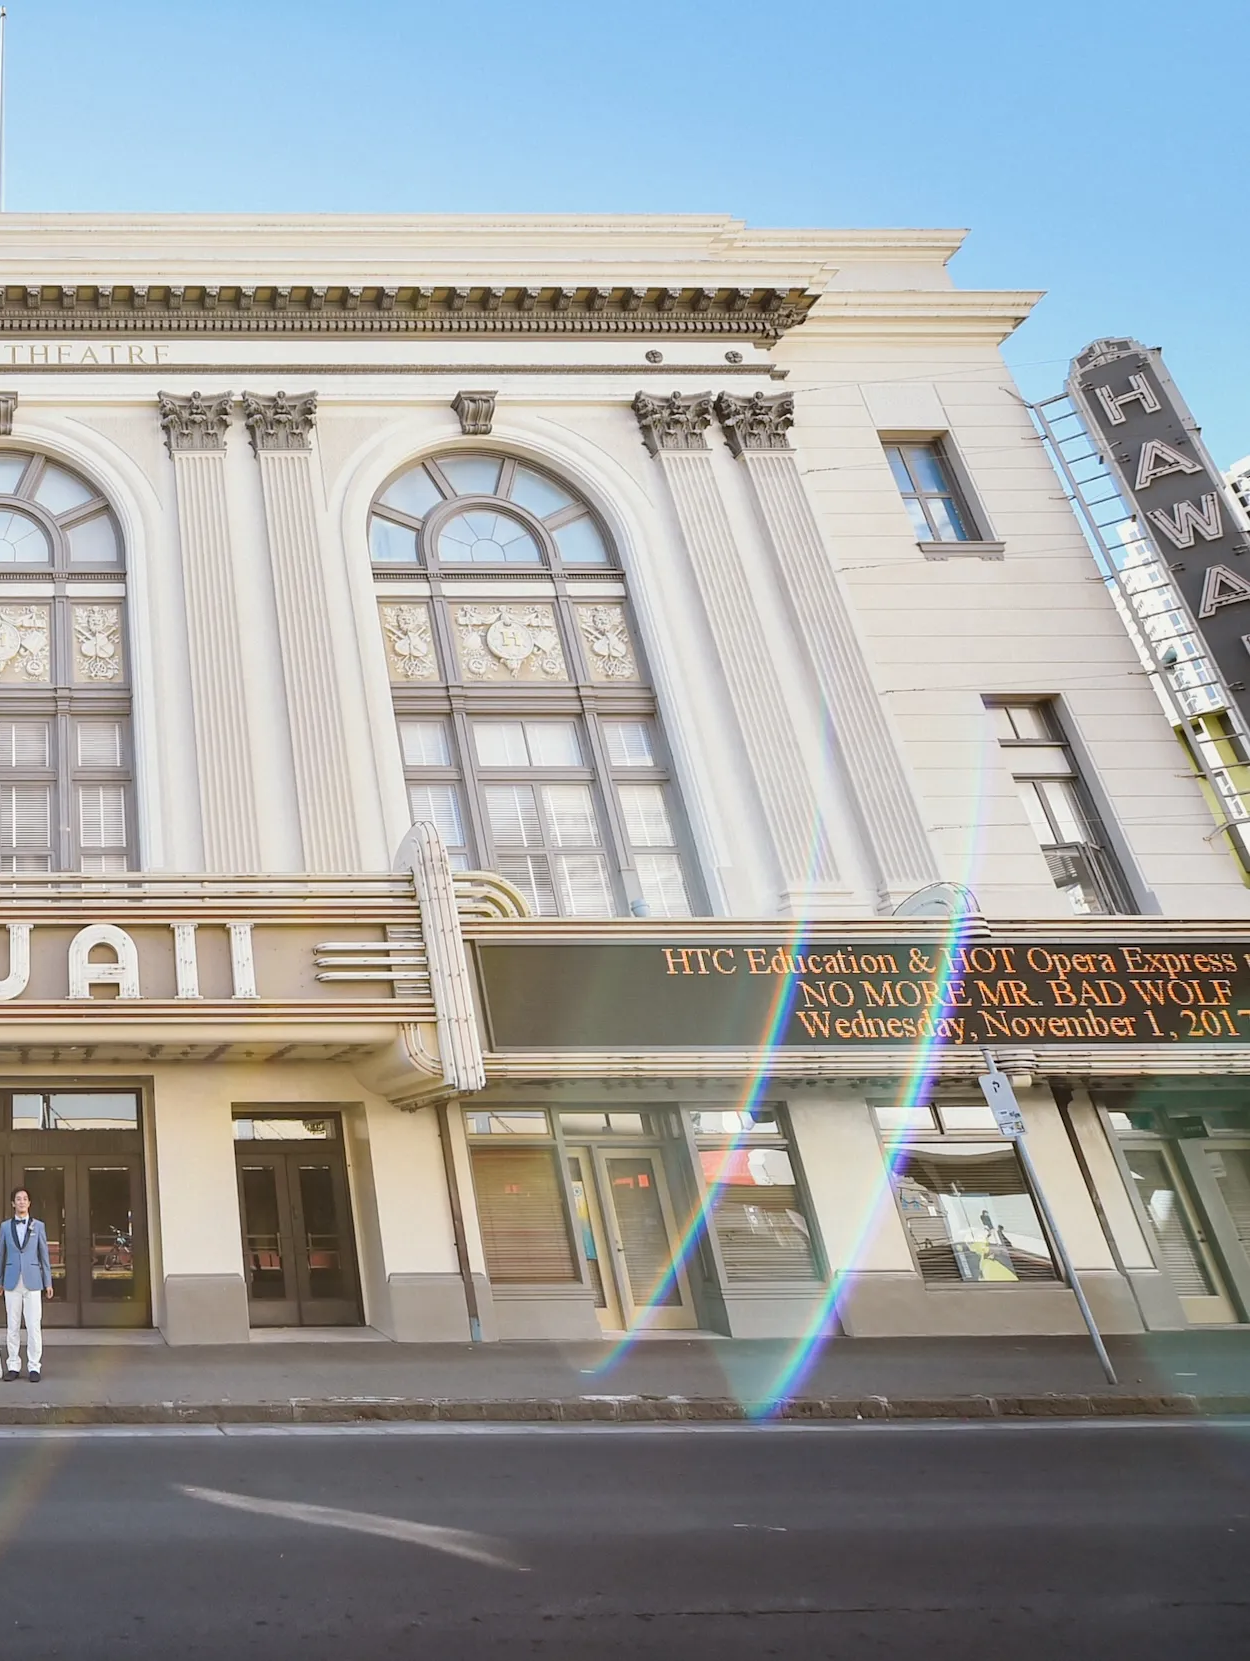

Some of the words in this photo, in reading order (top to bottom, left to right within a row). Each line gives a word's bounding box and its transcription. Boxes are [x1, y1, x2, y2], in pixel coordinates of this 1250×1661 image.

[4, 344, 170, 364] THEATRE
[500, 630, 523, 647] H
[661, 948, 737, 975] HTC
[743, 946, 900, 975] Education
[908, 947, 937, 974] &
[939, 947, 1016, 974] HOT
[1026, 947, 1118, 980] Opera
[1118, 946, 1238, 980] Express
[795, 980, 855, 1008] NO
[859, 980, 973, 1008] MORE
[973, 979, 1044, 1007] MR.
[1046, 979, 1128, 1007] BAD
[1128, 979, 1233, 1007] WOLF
[795, 1009, 979, 1045] Wednesday,
[977, 1008, 1137, 1038] November
[1143, 1009, 1178, 1041] 1,
